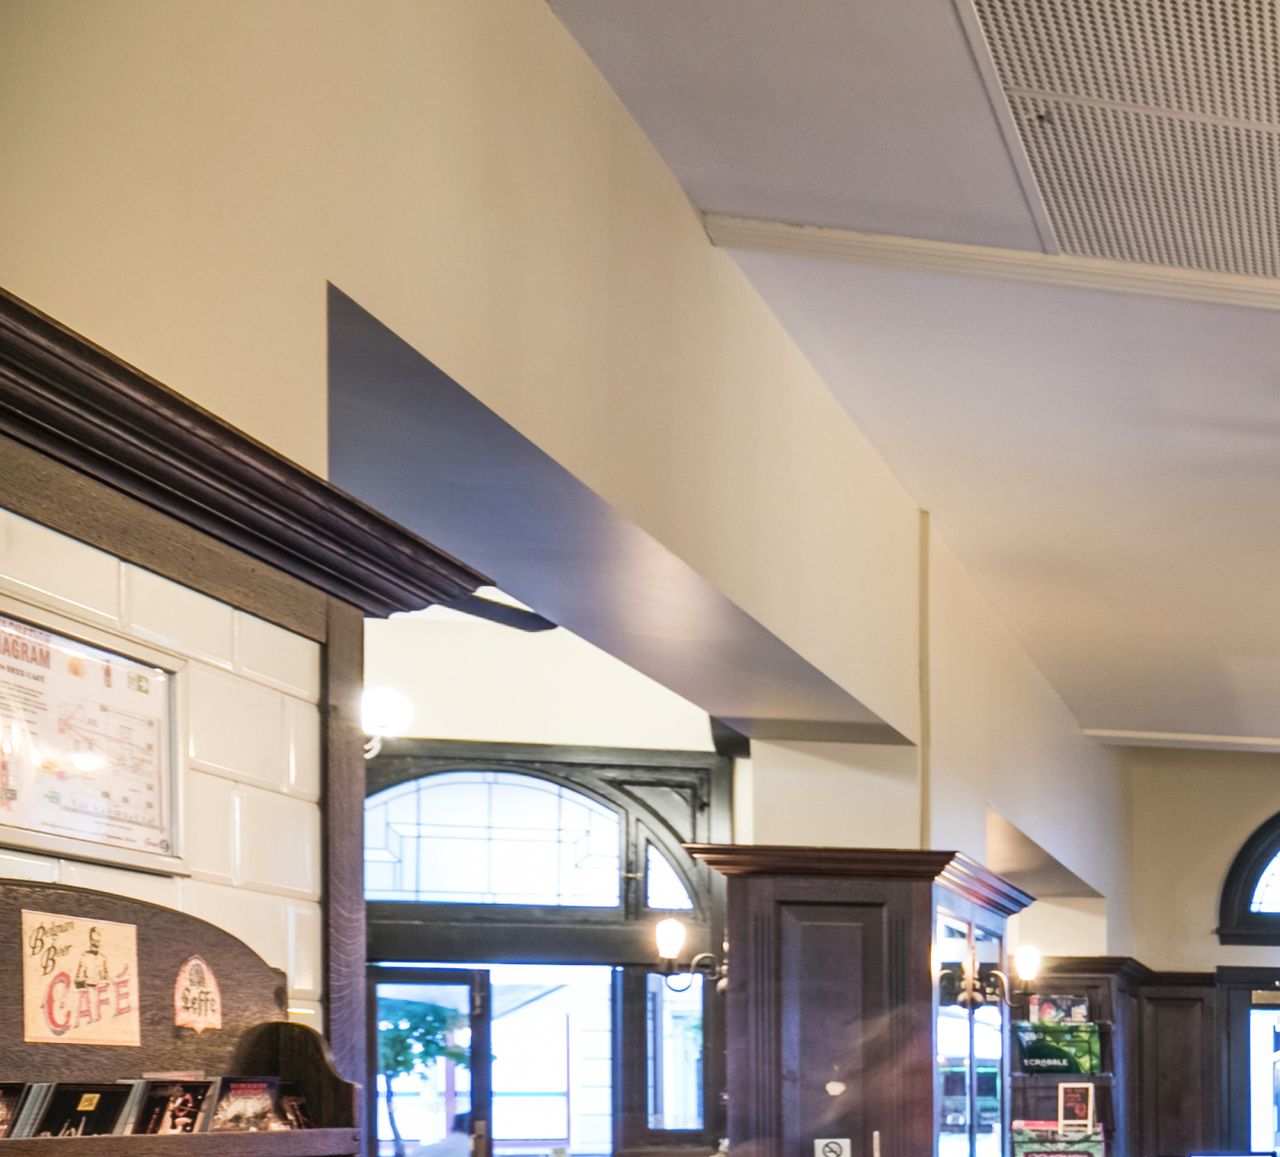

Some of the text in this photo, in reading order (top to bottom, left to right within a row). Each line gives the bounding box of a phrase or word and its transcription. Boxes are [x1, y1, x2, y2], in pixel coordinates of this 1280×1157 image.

[41, 944, 73, 976] Beer
[44, 963, 131, 1036] CAFÉ
[1023, 1058, 1068, 1067] SCRABBLE
